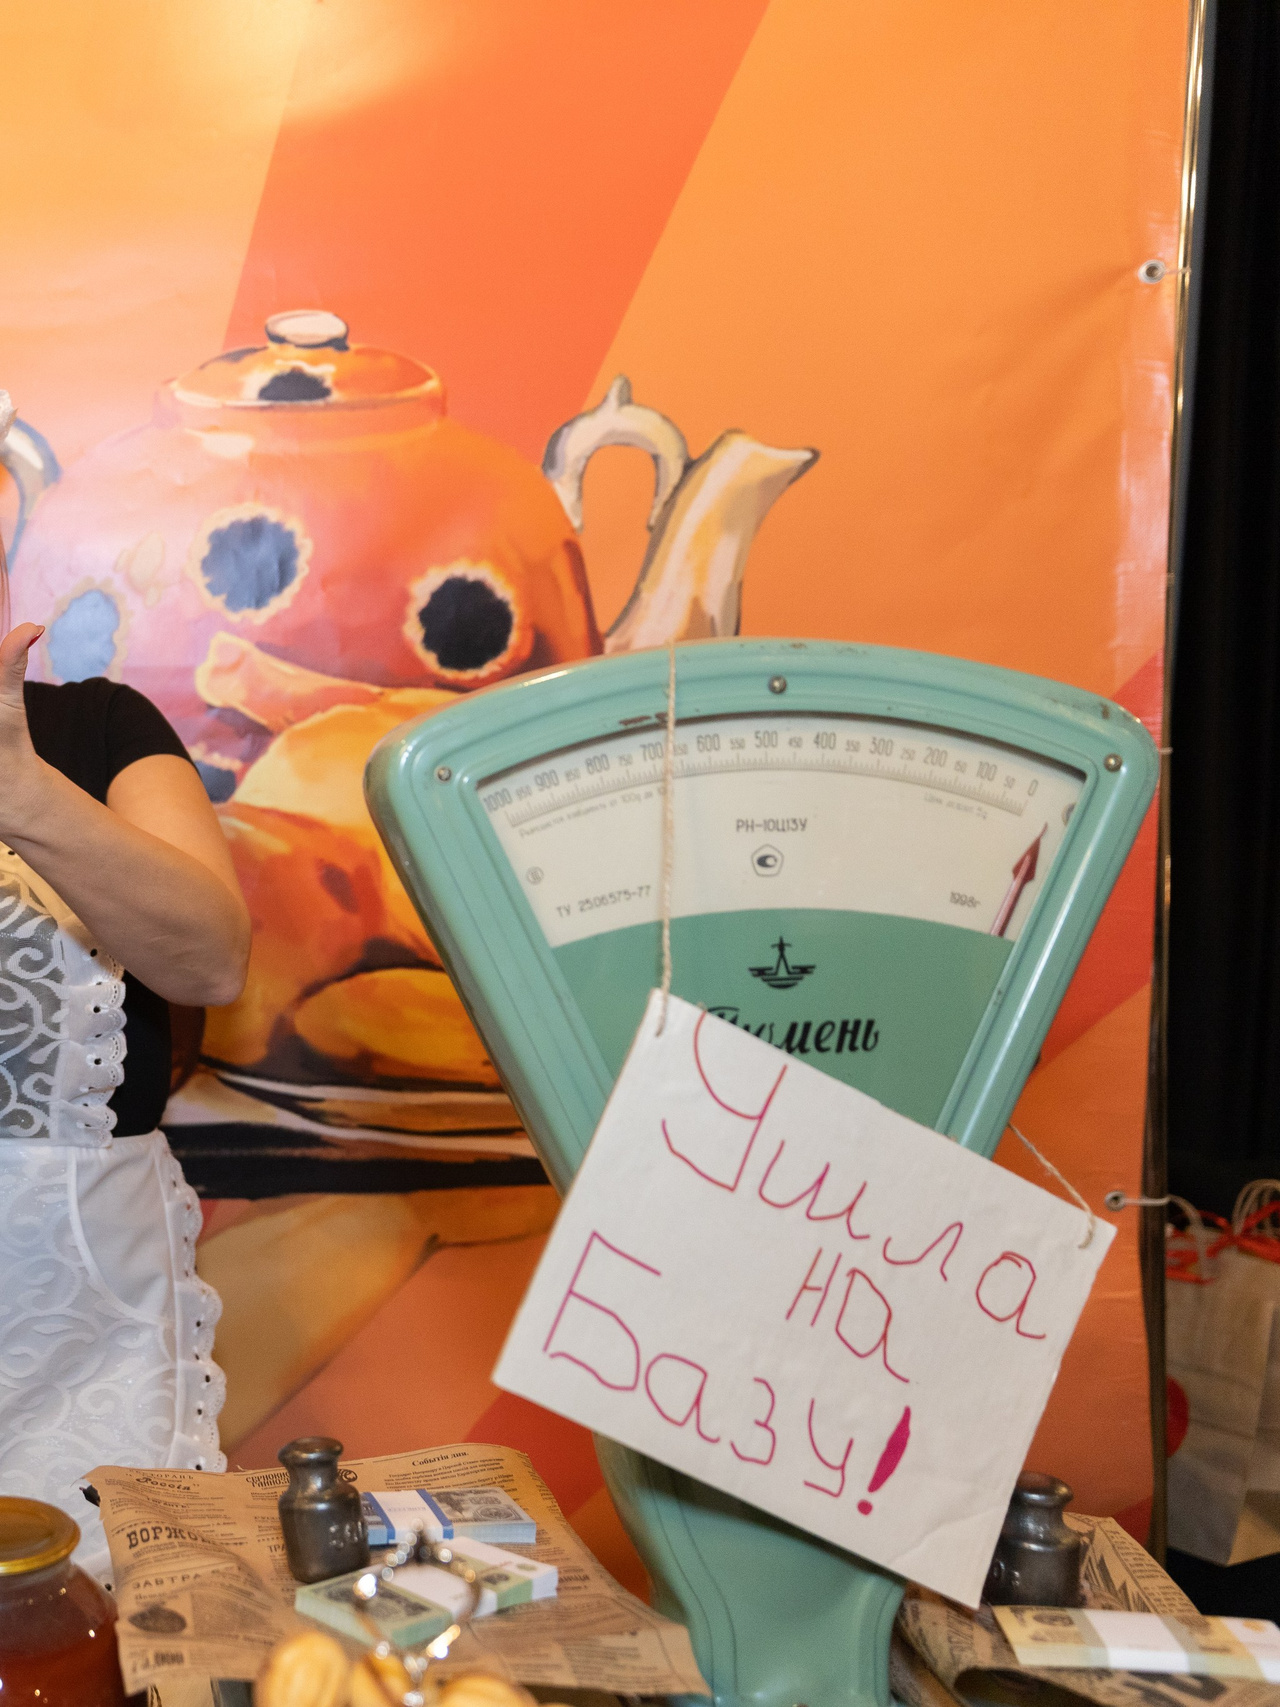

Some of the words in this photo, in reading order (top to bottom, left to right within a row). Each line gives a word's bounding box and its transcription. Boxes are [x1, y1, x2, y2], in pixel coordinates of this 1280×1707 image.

[483, 787, 513, 813] 1000
[534, 769, 560, 791] 900
[585, 752, 610, 775] 800
[619, 753, 633, 766] 750
[640, 741, 664, 761] 700
[696, 733, 720, 751] 600
[730, 737, 745, 750] 550
[754, 731, 778, 748] 500
[788, 736, 803, 748] 450
[813, 732, 836, 750] 400
[846, 739, 861, 752] 350
[870, 736, 894, 756] 300
[900, 747, 915, 761] 250
[923, 746, 948, 767] 200
[954, 760, 967, 773] 150
[976, 761, 998, 781] 100
[1004, 775, 1016, 789] 50
[1027, 778, 1039, 797] 0
[556, 904, 571, 918] ТУ
[661, 1011, 1047, 1340] Ушла
[542, 1231, 912, 1516] Базу!
[785, 1248, 910, 1383] на
